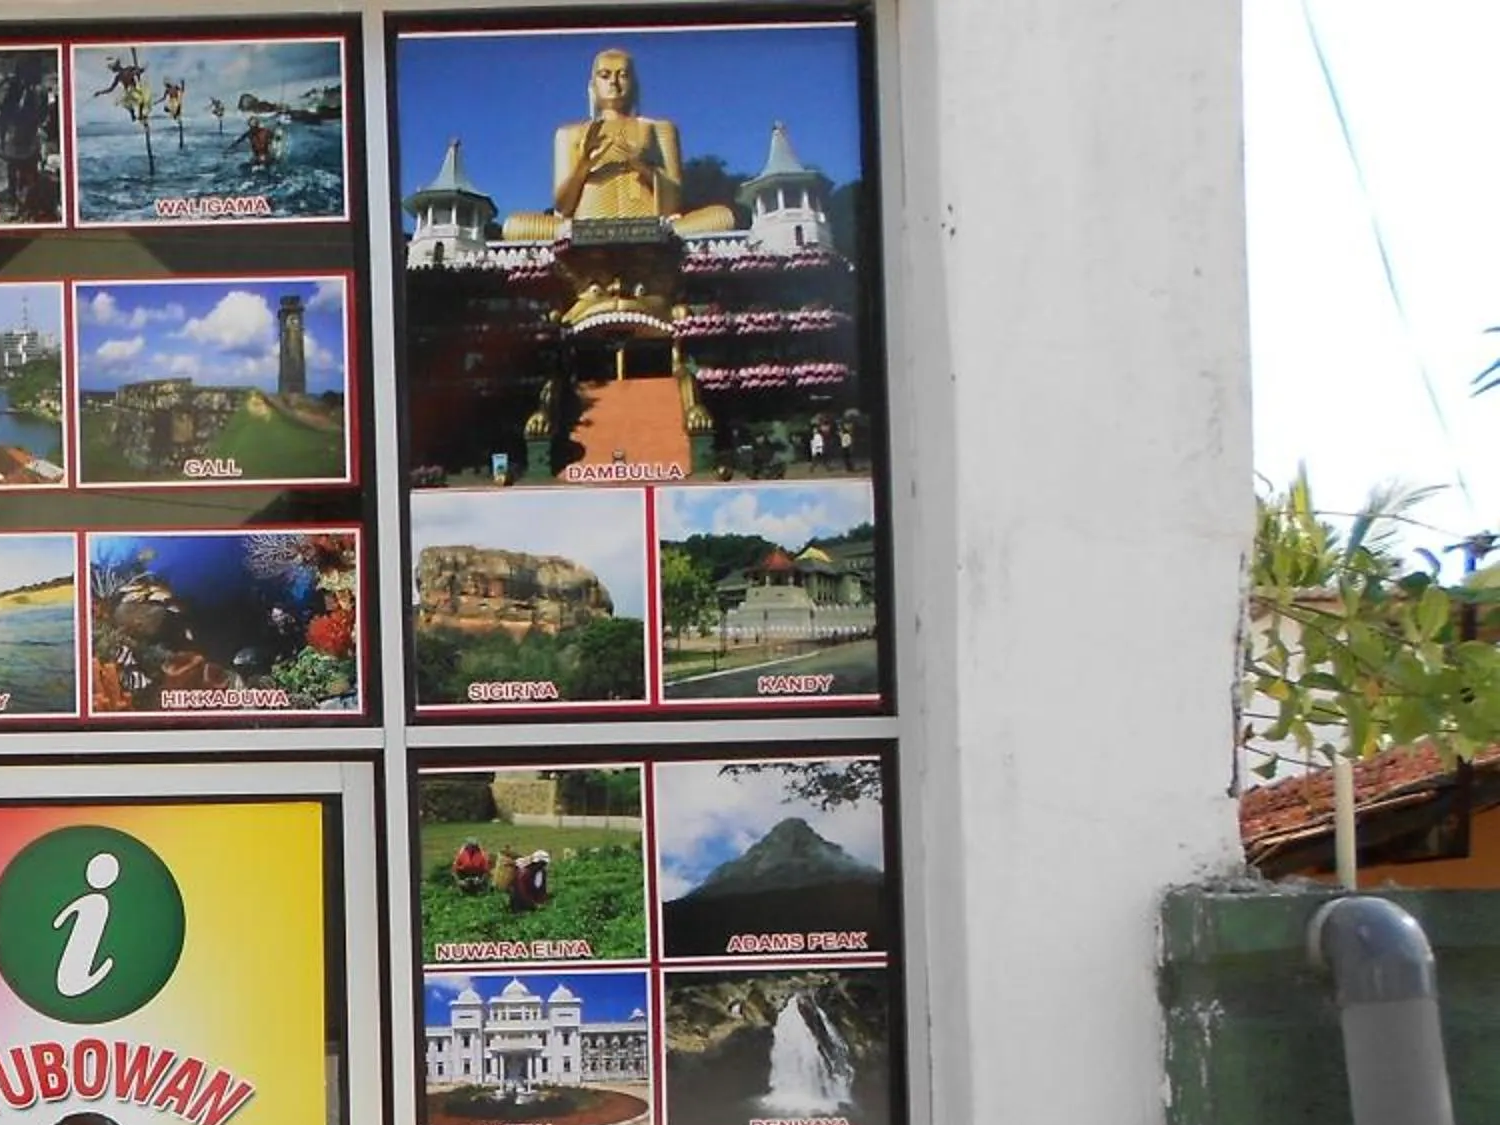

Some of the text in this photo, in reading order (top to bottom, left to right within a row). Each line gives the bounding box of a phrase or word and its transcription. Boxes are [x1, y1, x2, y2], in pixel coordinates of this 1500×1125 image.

[156, 196, 271, 216] WALIGAMA
[184, 458, 242, 477] GALL
[567, 464, 685, 482] DAMBULLA
[469, 681, 558, 700] SIGIRIYA
[758, 674, 834, 694] KANDY
[161, 689, 289, 708] HIKKADUWA
[436, 940, 592, 960] NUWARA ELIYA
[727, 931, 868, 953] ADAMS PEAK
